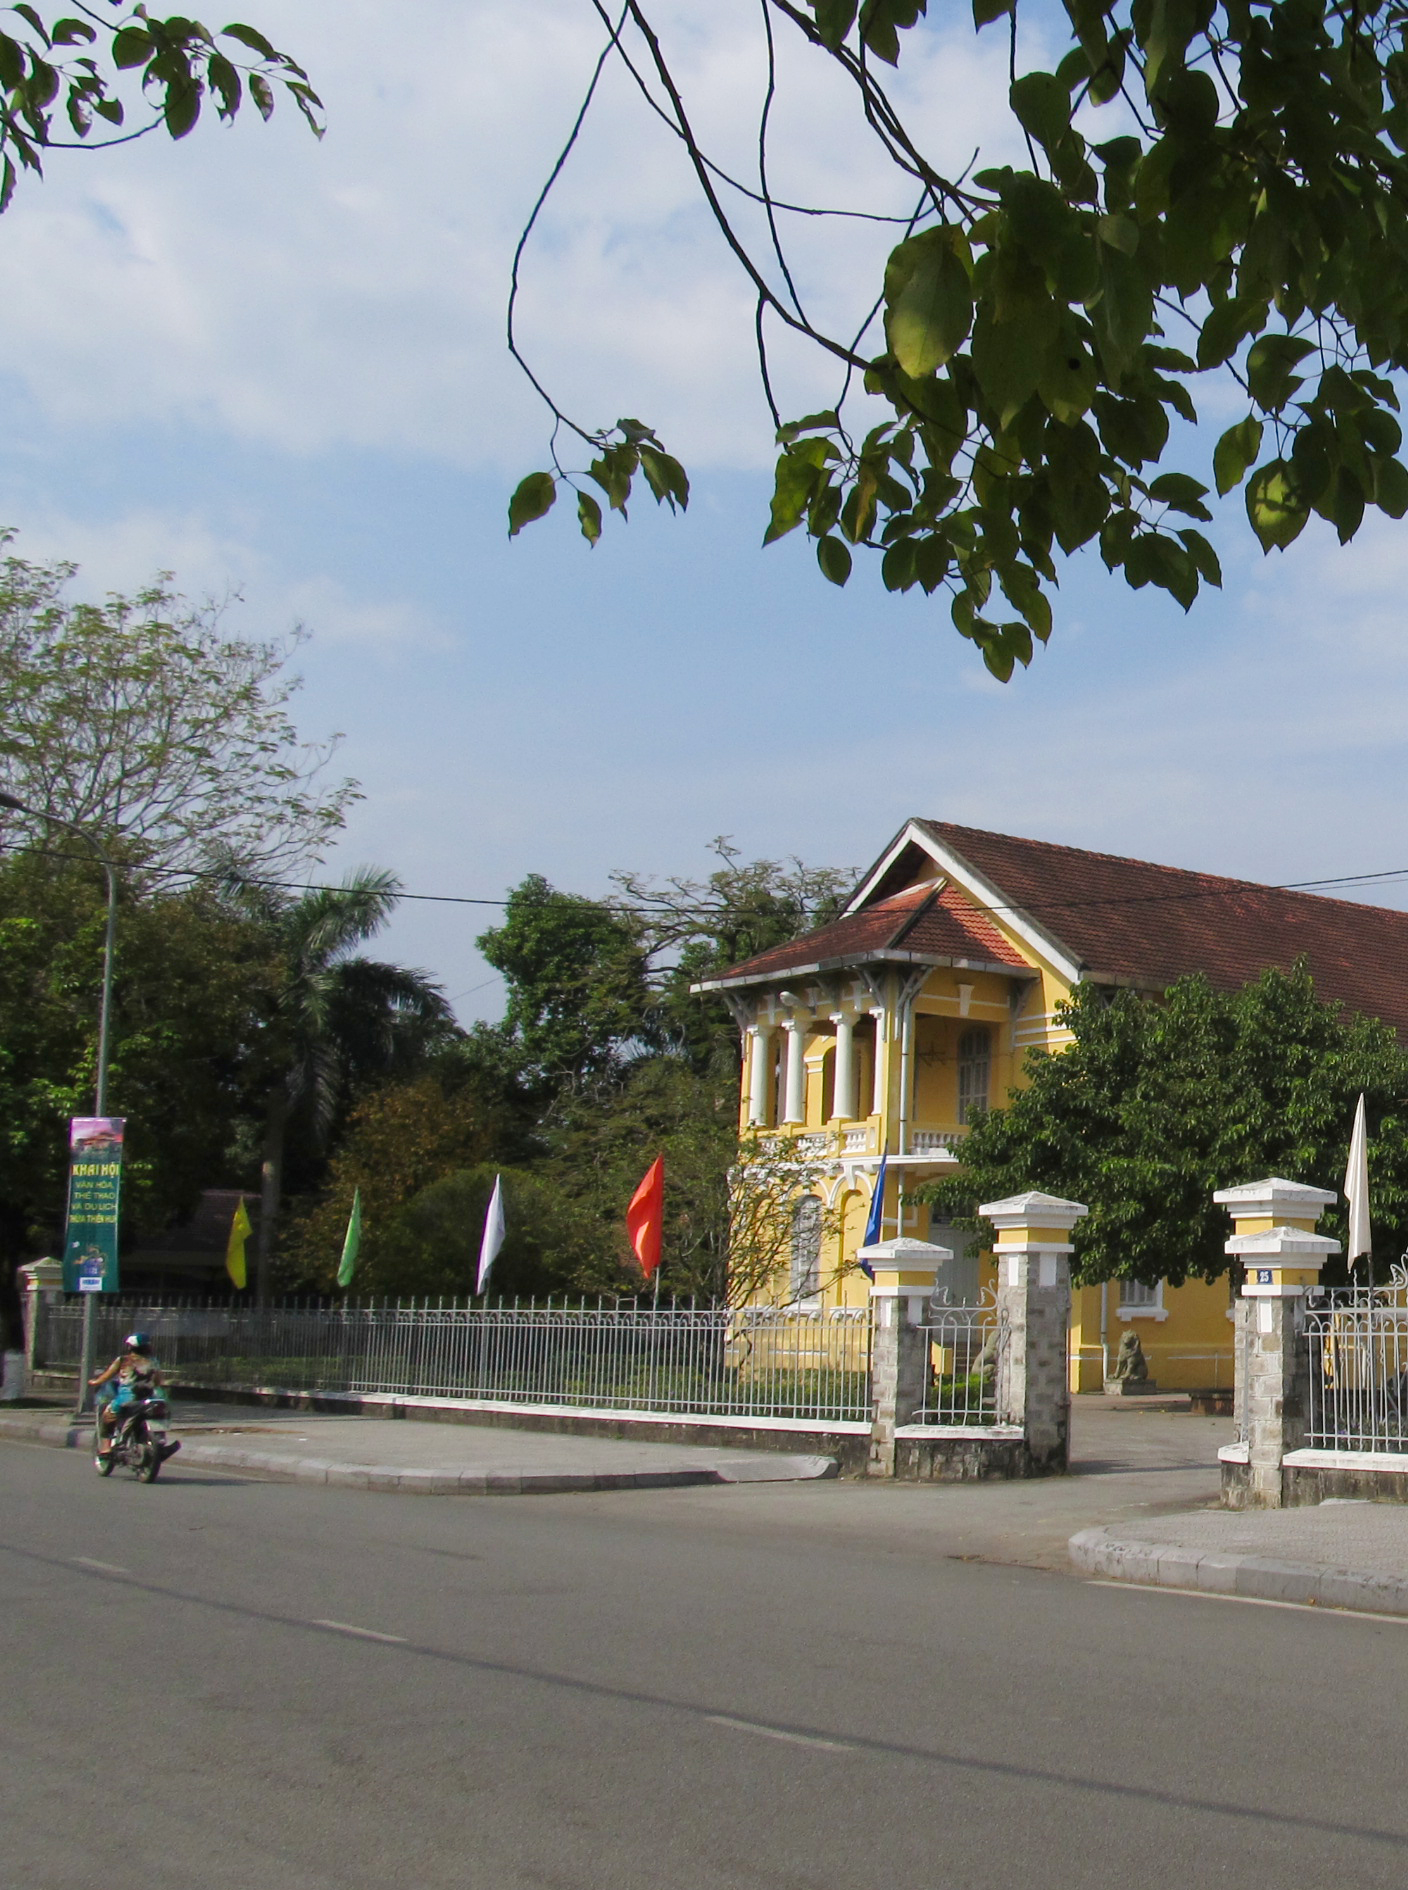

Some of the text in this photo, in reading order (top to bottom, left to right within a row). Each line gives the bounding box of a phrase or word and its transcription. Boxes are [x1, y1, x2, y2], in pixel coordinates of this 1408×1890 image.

[72, 1161, 119, 1178] KHAI HỘI
[1259, 1271, 1269, 1282] 25
